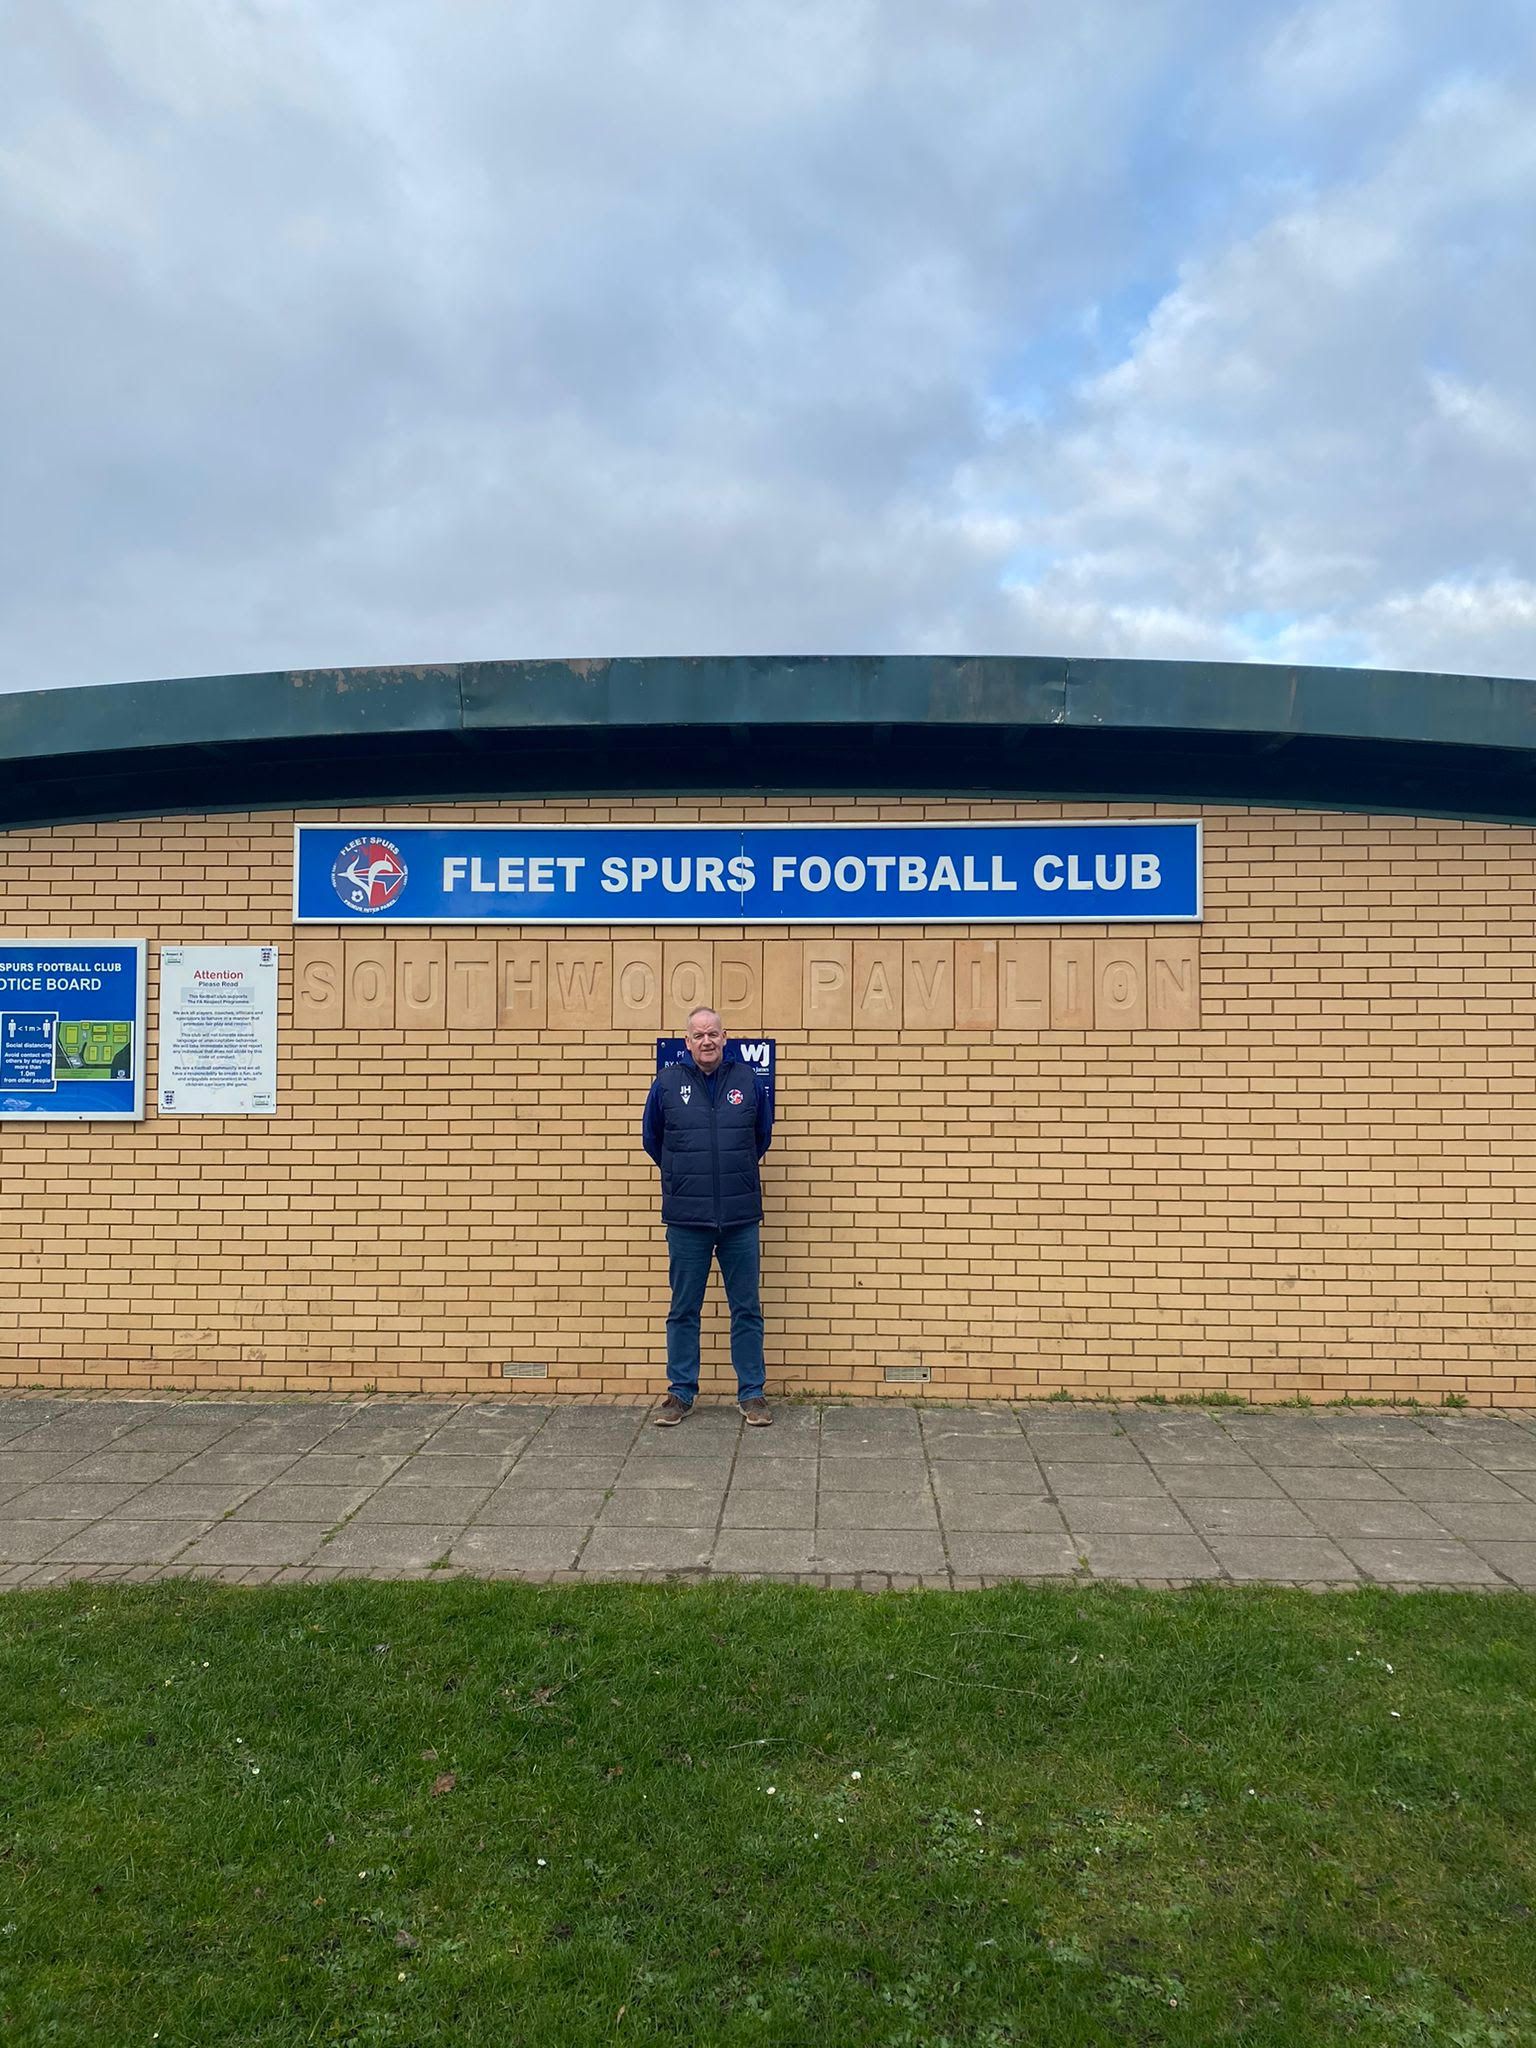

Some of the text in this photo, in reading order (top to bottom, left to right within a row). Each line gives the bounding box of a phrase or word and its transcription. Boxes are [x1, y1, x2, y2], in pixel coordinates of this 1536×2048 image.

[340, 836, 400, 856] FLEET SPURS
[443, 857, 585, 892] FLEET
[601, 856, 756, 892] SPURS
[772, 855, 1017, 892] FOOTBALL
[1033, 854, 1161, 891] CLUB
[0, 963, 122, 972] SPURS FOOTBALL CLUB
[193, 970, 244, 980] Attention
[0, 978, 101, 991] OTICE BOARD
[301, 959, 1191, 1010] SOUTHWOOD PAVILION
[23, 1042, 52, 1050] distancing
[680, 1085, 692, 1094] JH
